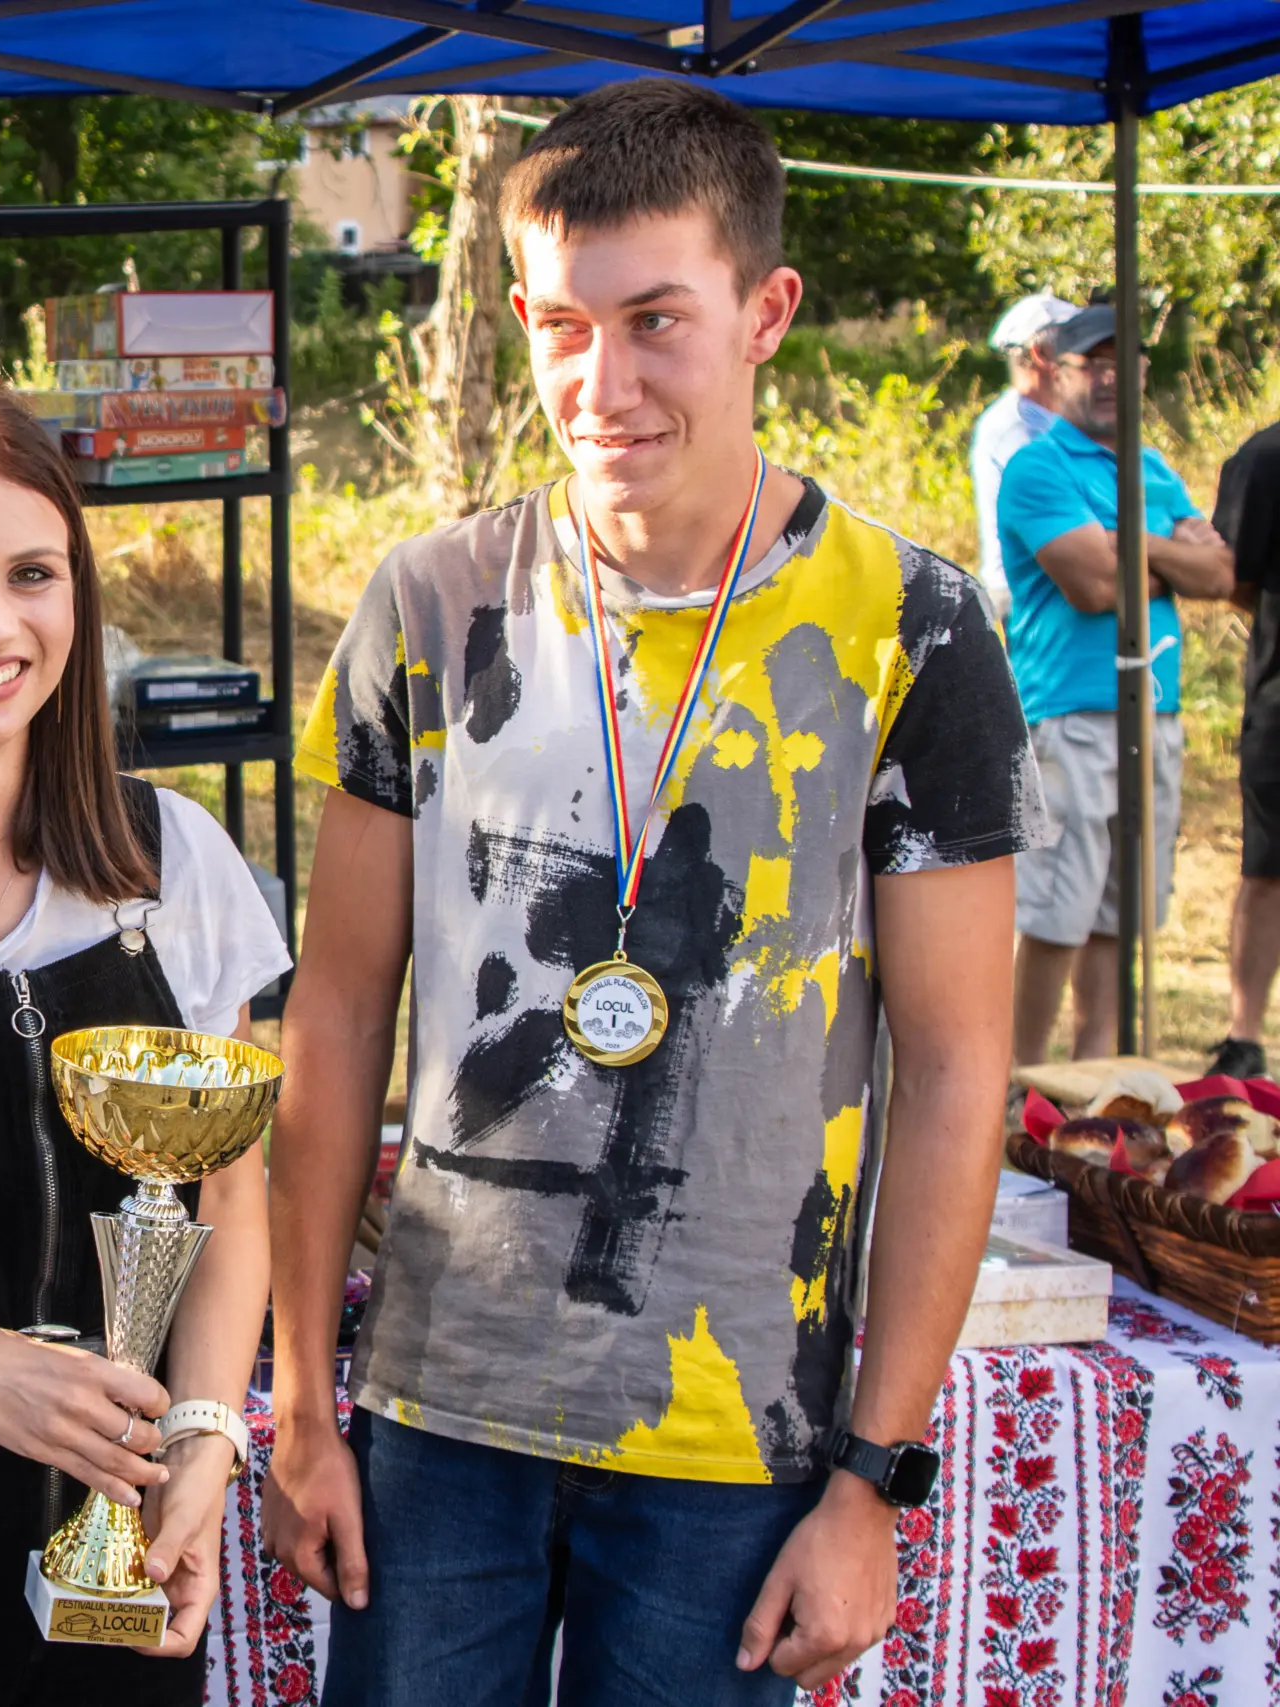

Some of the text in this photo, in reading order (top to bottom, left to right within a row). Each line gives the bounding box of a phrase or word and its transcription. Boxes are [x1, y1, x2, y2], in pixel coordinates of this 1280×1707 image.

[139, 431, 203, 448] MONOPOLY
[581, 978, 613, 1005] FESTIVALUL
[596, 1000, 634, 1014] LOCUL
[611, 1014, 617, 1028] I
[57, 1599, 106, 1611] FESTIVALUL
[103, 1615, 159, 1633] LOCUL I
